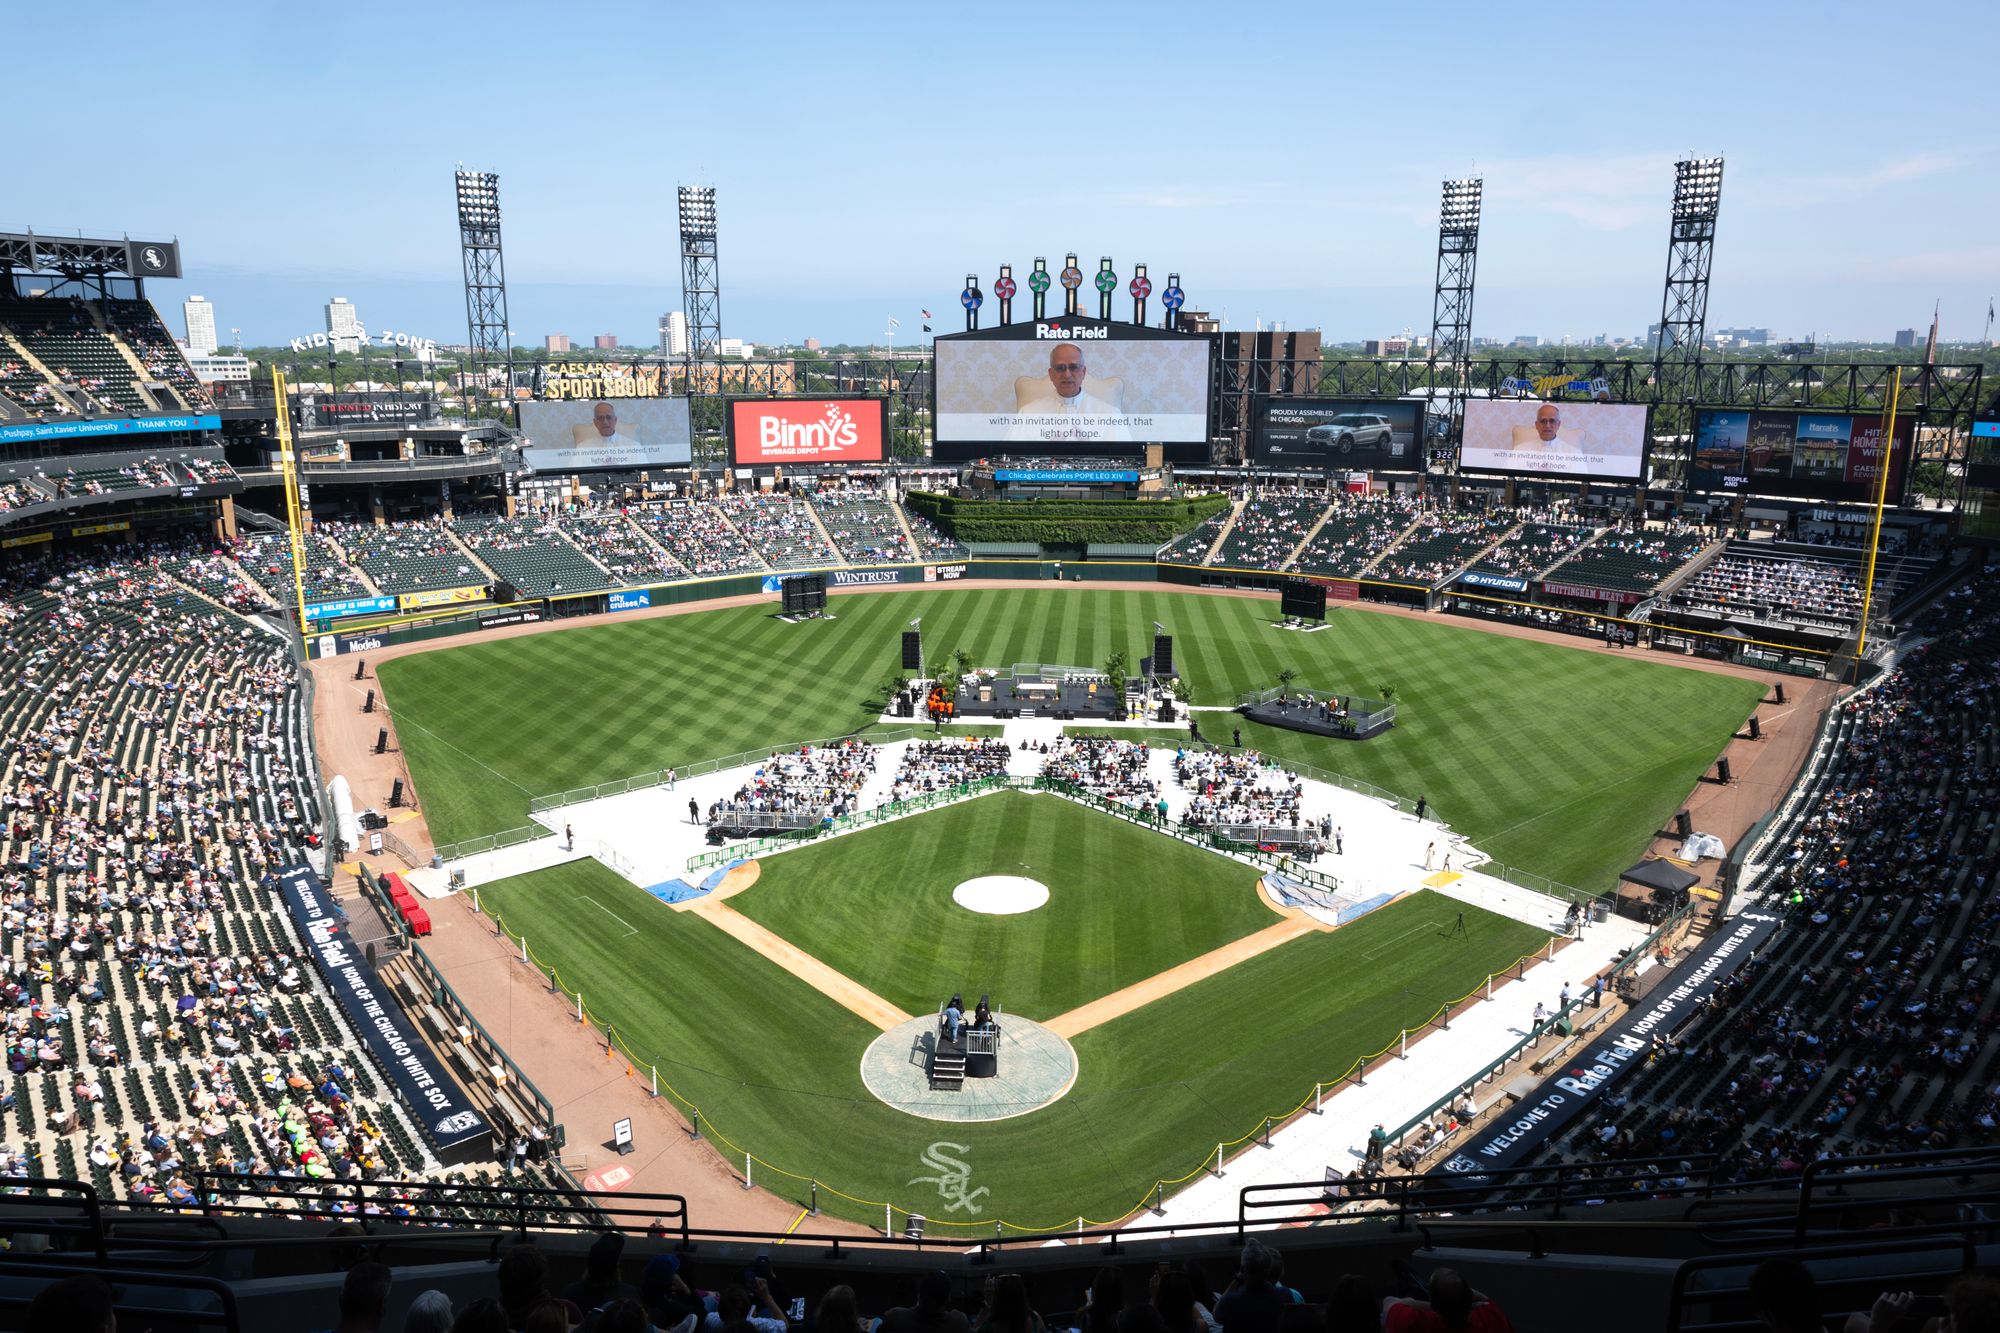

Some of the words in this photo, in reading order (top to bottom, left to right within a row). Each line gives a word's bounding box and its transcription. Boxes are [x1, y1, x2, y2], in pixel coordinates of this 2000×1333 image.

[1037, 324, 1070, 339] Rate
[1073, 326, 1107, 338] Field
[290, 331, 341, 352] KIDS
[382, 331, 435, 352] ZONE
[548, 364, 613, 374] CAESARS
[548, 378, 658, 398] SPORTSBOOK
[1532, 374, 1580, 394] Miller
[1568, 382, 1590, 390] TIME
[36, 427, 53, 435] Saint
[79, 424, 118, 432] University
[136, 420, 165, 428] THANK
[167, 419, 187, 427] YOU
[1098, 418, 1131, 426] indeed,
[760, 413, 858, 450] Binny's
[1041, 429, 1060, 439] light
[1063, 429, 1073, 437] of
[1076, 430, 1101, 439] hope.
[1853, 437, 1879, 448] HOME
[1881, 438, 1900, 449] RN
[651, 481, 676, 491] Modelo
[1812, 509, 1835, 521] Lite
[1480, 577, 1521, 588] HYUNDAI
[1544, 584, 1596, 599] WHITTINGHAM
[1598, 590, 1625, 602] MEATS
[323, 603, 346, 611] RELIEF
[610, 600, 637, 609] cruises
[350, 639, 381, 652] Modelo
[294, 879, 319, 910] WELCOME
[308, 907, 323, 918] TO
[306, 918, 335, 944] Rate
[318, 940, 353, 968] Field
[341, 966, 366, 989] HOME
[355, 988, 373, 1000] OF
[363, 1000, 384, 1018] THE
[374, 1016, 411, 1056] CHICAGO
[1480, 1107, 1550, 1156] WELCOME
[1540, 1095, 1565, 1109] TO
[1554, 1065, 1614, 1096] Rate
[1594, 1034, 1646, 1068] Field
[1631, 1010, 1666, 1035] HOME
[1657, 999, 1676, 1012] OF
[1673, 985, 1693, 1001] THE
[1689, 956, 1723, 987] CHICAGO
[1713, 936, 1744, 958] WHITE
[1734, 923, 1756, 938] SOX
[401, 1055, 435, 1088] WHITE
[424, 1088, 452, 1111] SOX
[450, 1111, 481, 1132] 125
